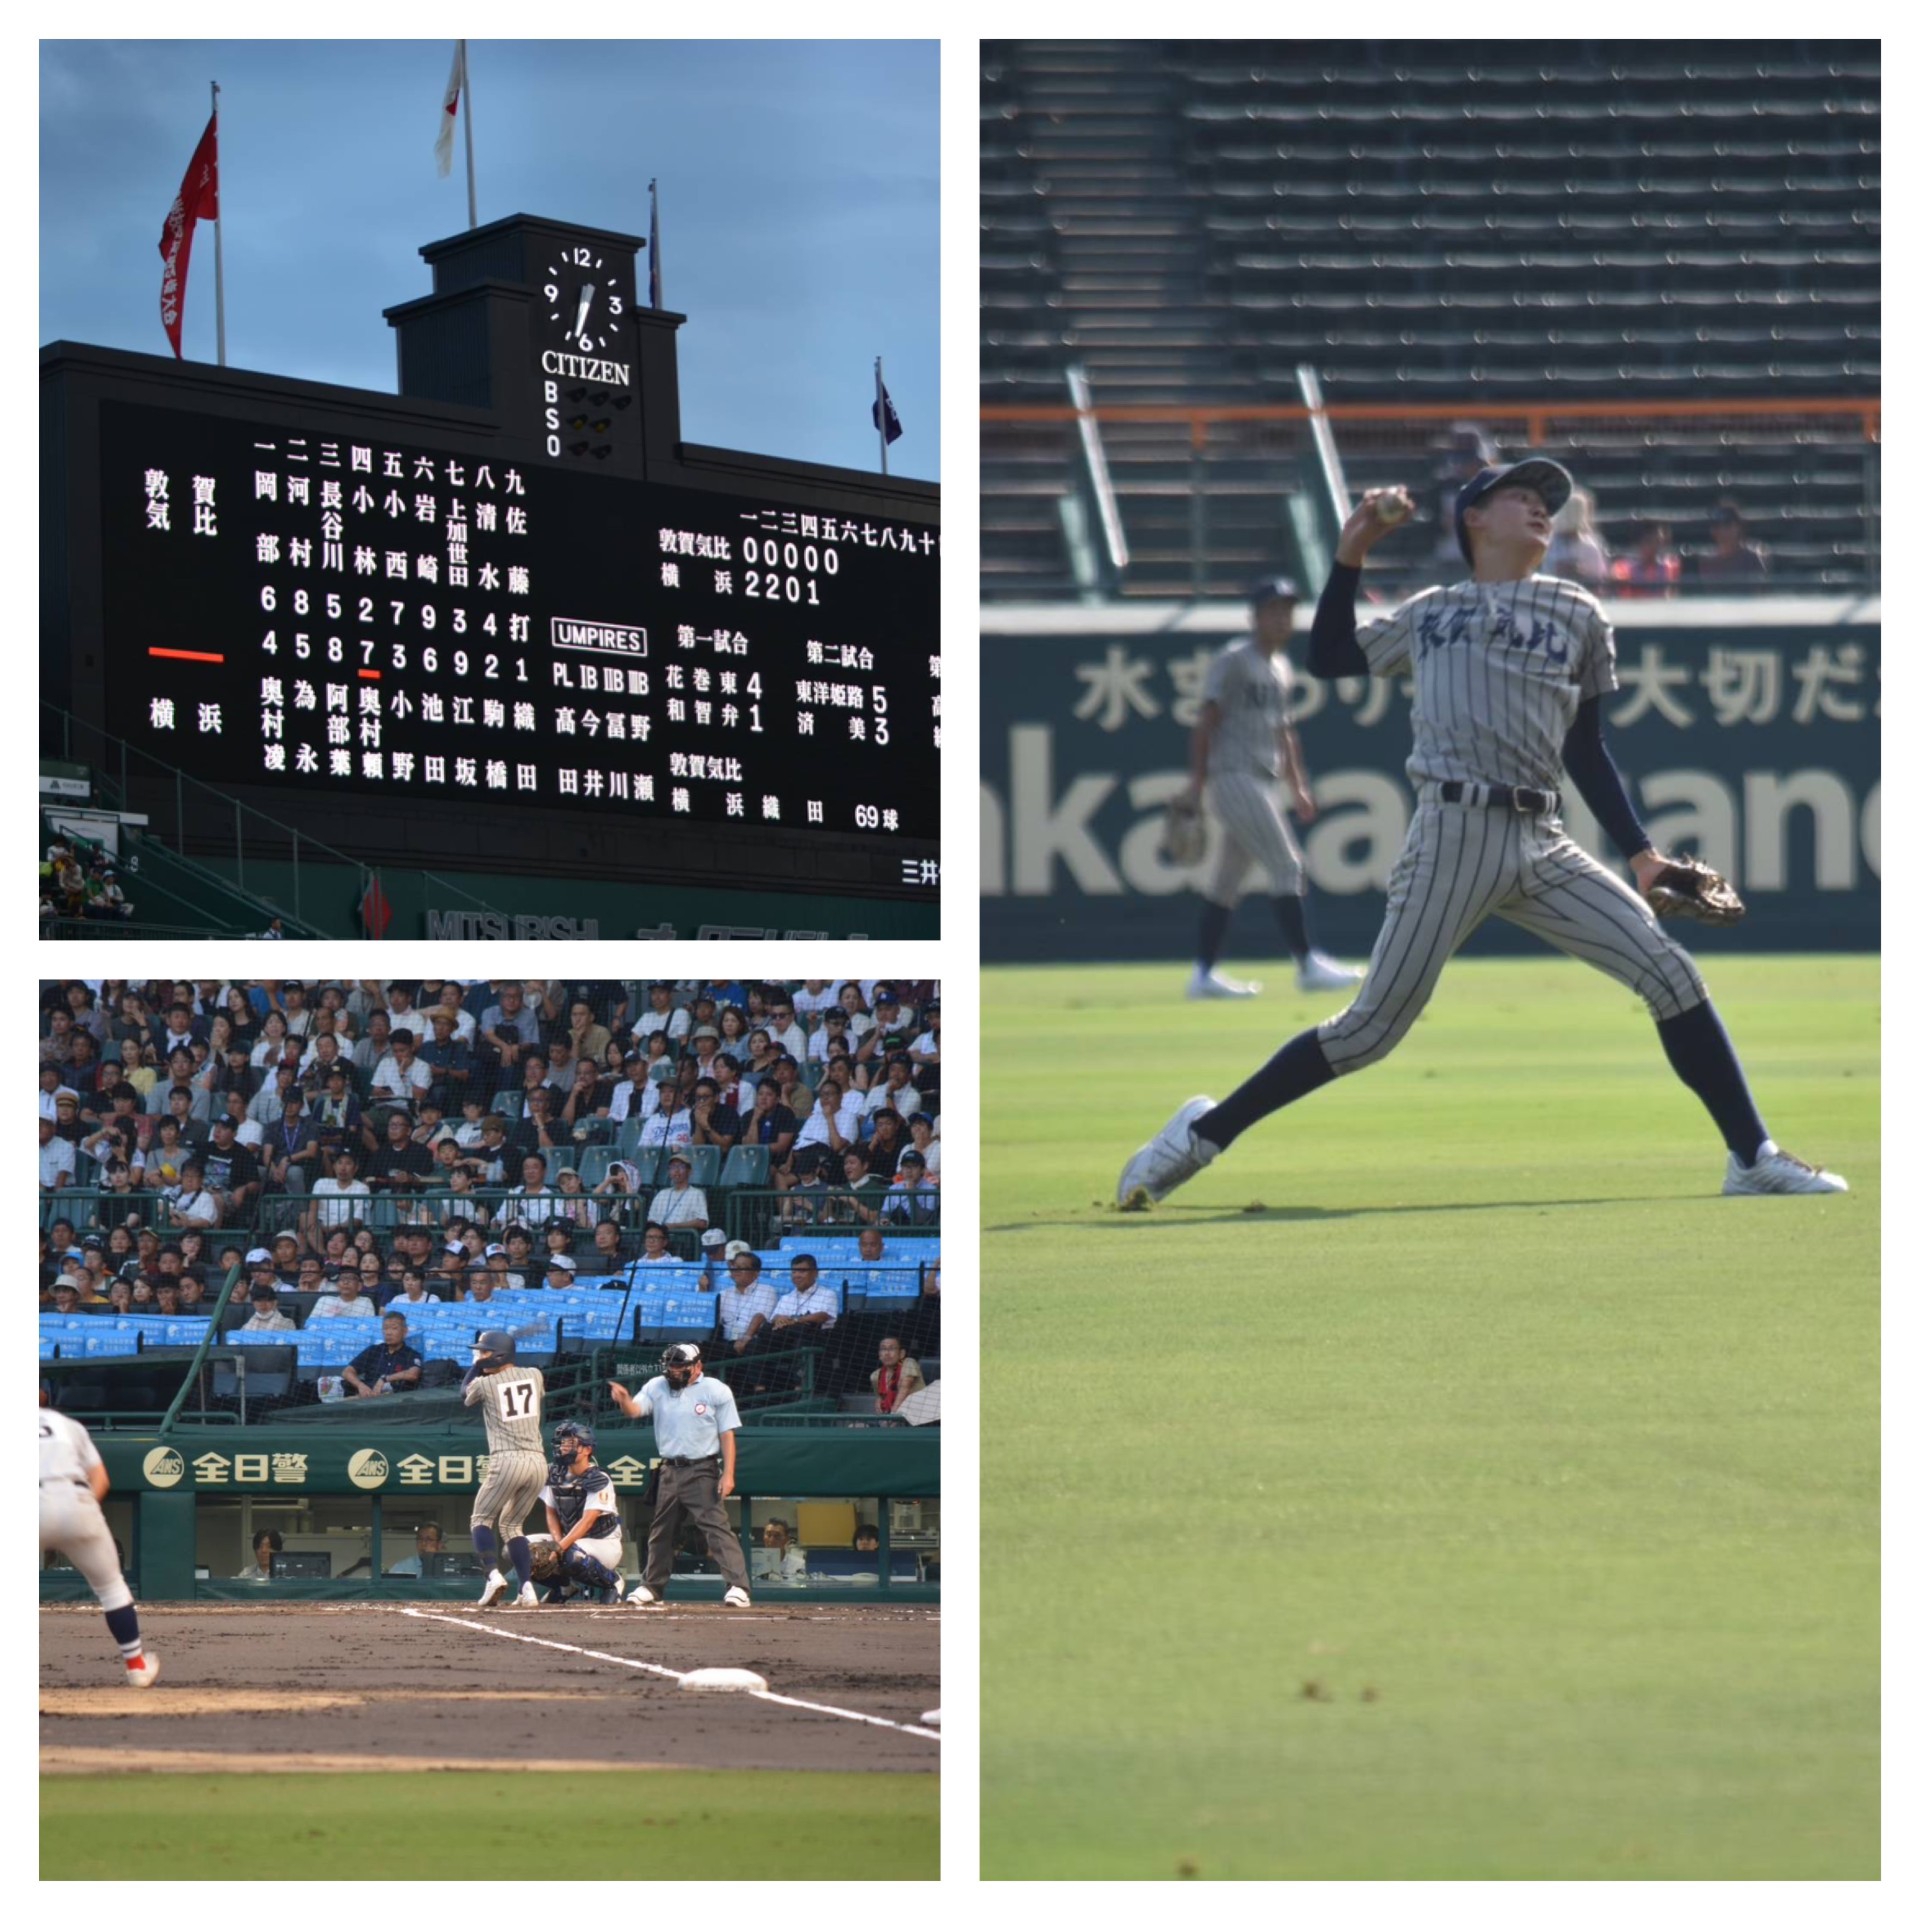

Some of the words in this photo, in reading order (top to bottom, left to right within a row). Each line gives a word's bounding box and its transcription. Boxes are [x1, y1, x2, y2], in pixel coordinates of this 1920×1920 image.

[574, 248, 590, 267] 12
[544, 284, 558, 302] 9
[609, 296, 622, 314] 3
[578, 334, 593, 351] 6
[542, 350, 629, 386] CITIZEN
[545, 381, 557, 403] B
[546, 408, 559, 430] S
[288, 440, 308, 460] 二
[320, 444, 340, 466] 三
[352, 446, 371, 473] 四
[384, 453, 403, 477] 五
[415, 457, 434, 481] 六
[446, 461, 464, 486] 七
[476, 466, 495, 489] 八
[506, 469, 524, 494] 九
[256, 471, 280, 563] 岡部
[288, 476, 312, 567] 河村
[321, 481, 343, 571] 長谷川
[353, 486, 376, 575] 小林
[385, 490, 407, 579] 小西
[447, 499, 468, 587] 上加世田
[477, 503, 499, 590] 清水
[506, 507, 529, 594] 佐藤
[660, 528, 731, 560] 敦賀気比
[262, 586, 276, 610] 6
[295, 590, 308, 614] 8
[328, 594, 341, 618] 5
[359, 598, 373, 621] 2
[391, 602, 404, 624] 7
[422, 605, 435, 629] 9
[454, 609, 466, 633] 3
[483, 613, 497, 635] 4
[510, 614, 529, 642] 打
[558, 624, 641, 652] UMPIRES
[678, 625, 748, 655] 第一試合
[807, 640, 873, 669] 第二試合
[262, 631, 277, 654] 4
[296, 634, 310, 658] 5
[329, 637, 342, 661] 8
[361, 641, 374, 664] 7
[393, 644, 406, 668] 3
[424, 648, 437, 671] 6
[454, 651, 468, 675] 9
[485, 654, 498, 678] 2
[516, 659, 527, 681] 1
[554, 663, 573, 687] PL
[666, 665, 737, 694] 花巻東
[747, 672, 762, 699] 4
[796, 680, 863, 708] 東洋姫路
[873, 686, 886, 713] 5
[295, 680, 318, 772] 為永
[668, 698, 738, 726] 和智弁
[750, 705, 762, 731] 1
[875, 718, 888, 744] 3
[391, 690, 414, 781] 小野
[422, 693, 444, 782] 池田
[453, 697, 477, 785] 江坂
[484, 700, 506, 788] 駒橋
[514, 702, 536, 790] 織田
[670, 753, 742, 781] 敦賀気比
[901, 859, 940, 886] 三井
[503, 1382, 533, 1418] 17
[152, 1457, 183, 1475] ANS
[192, 1452, 309, 1484] 全日警
[357, 1459, 388, 1477] ANS
